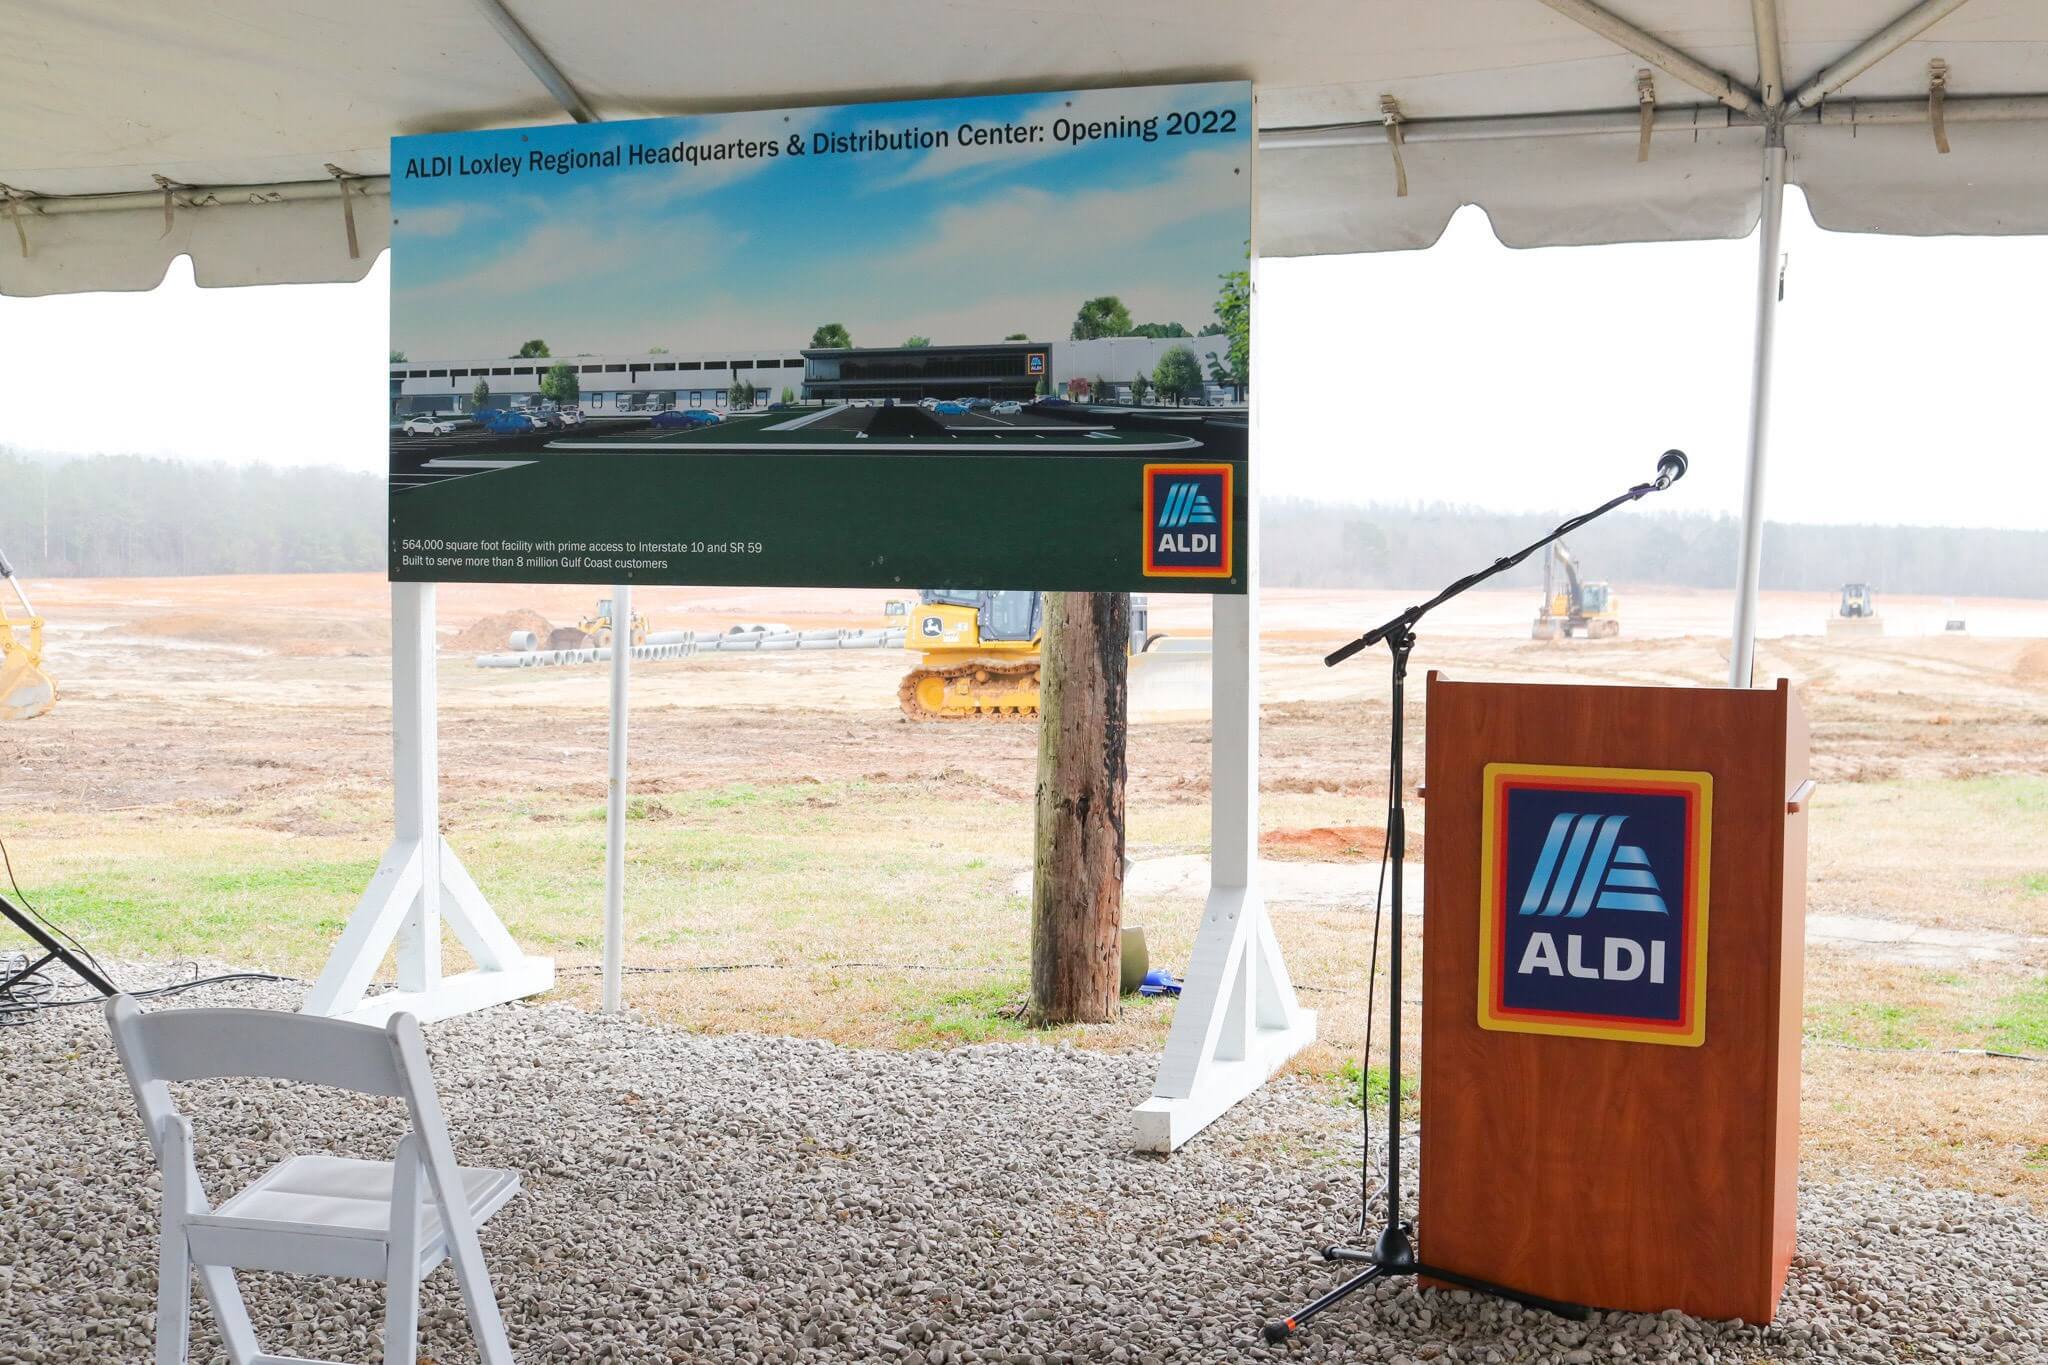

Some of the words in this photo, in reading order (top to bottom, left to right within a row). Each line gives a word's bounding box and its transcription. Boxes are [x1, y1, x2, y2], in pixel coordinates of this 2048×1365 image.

[405, 156, 452, 179] ALDI
[459, 153, 522, 177] Loxley
[529, 145, 620, 174] Regional
[629, 137, 779, 165] Headquarters
[786, 134, 806, 156] &
[813, 123, 949, 154] Distribution
[957, 118, 1044, 146] Center:
[1053, 115, 1159, 145] Opening
[1166, 110, 1237, 136] 2022
[402, 539, 443, 550] 564,000
[445, 541, 478, 551] square
[480, 540, 499, 550] foot
[502, 540, 532, 553] facility
[535, 541, 555, 551] with
[558, 540, 586, 553] prime
[589, 543, 623, 552] access
[626, 542, 636, 552] to
[639, 542, 687, 553] Interstate
[691, 542, 704, 552] 10
[707, 542, 727, 553] and
[730, 543, 744, 553] SR
[748, 543, 762, 553] 59
[1158, 534, 1216, 553] ALDI
[402, 555, 423, 566] Built
[426, 556, 435, 566] to
[437, 557, 463, 566] serve
[465, 558, 490, 566] more
[492, 557, 514, 566] than
[516, 557, 523, 566] 8
[526, 557, 558, 567] million
[561, 557, 582, 567] Gulf
[584, 557, 612, 568] Coast
[615, 558, 668, 569] customers
[1518, 932, 1666, 984] ALDI
